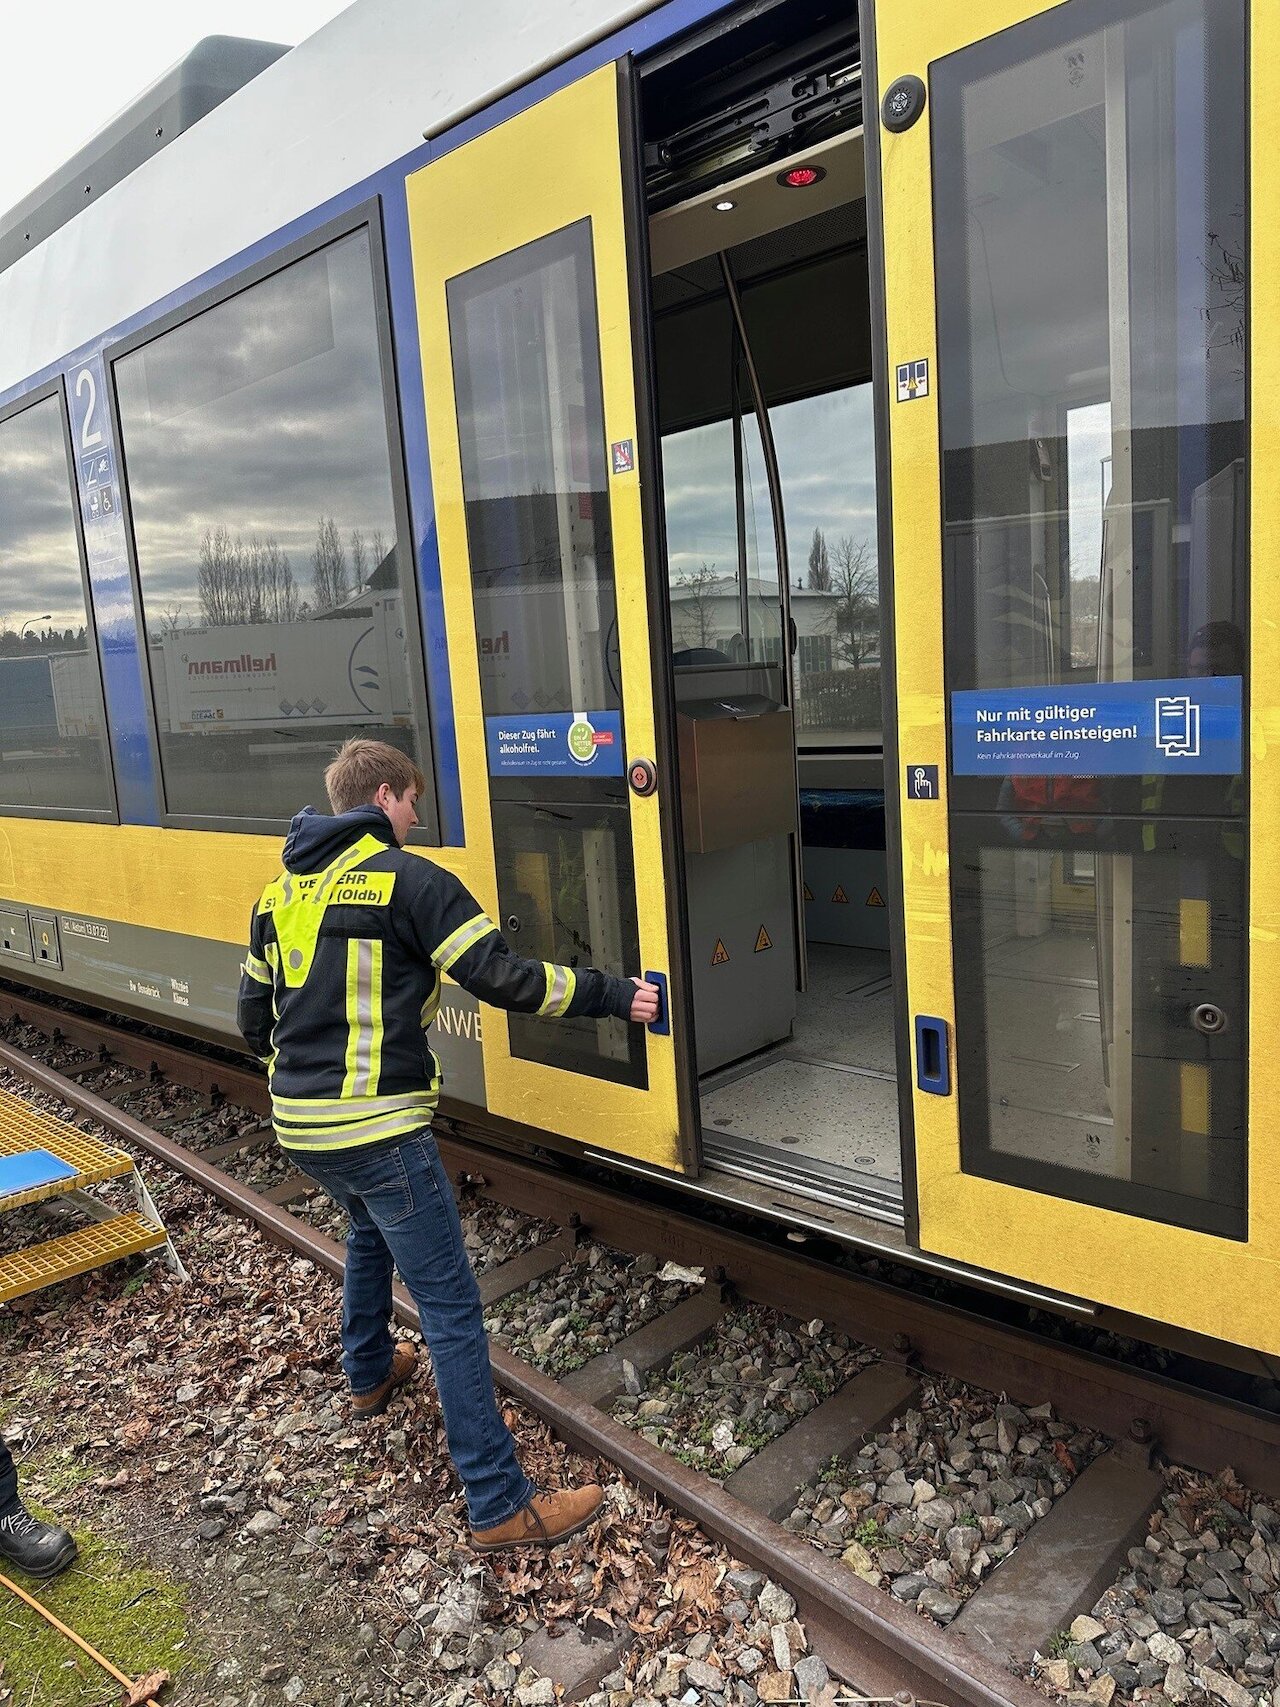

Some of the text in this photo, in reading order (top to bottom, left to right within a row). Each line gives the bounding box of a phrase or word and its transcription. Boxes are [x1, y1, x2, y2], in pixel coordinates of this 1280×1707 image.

[75, 368, 102, 449] 2
[976, 705, 1097, 723] Nur mit gültiger
[499, 728, 556, 741] Dieser Zug fährt
[977, 725, 1137, 742] Fahrkarte einsteigen!
[500, 743, 540, 753] alkoholfrei.
[992, 751, 1053, 760] Fahrkartenverkauf
[337, 889, 383, 904] (Oldb)
